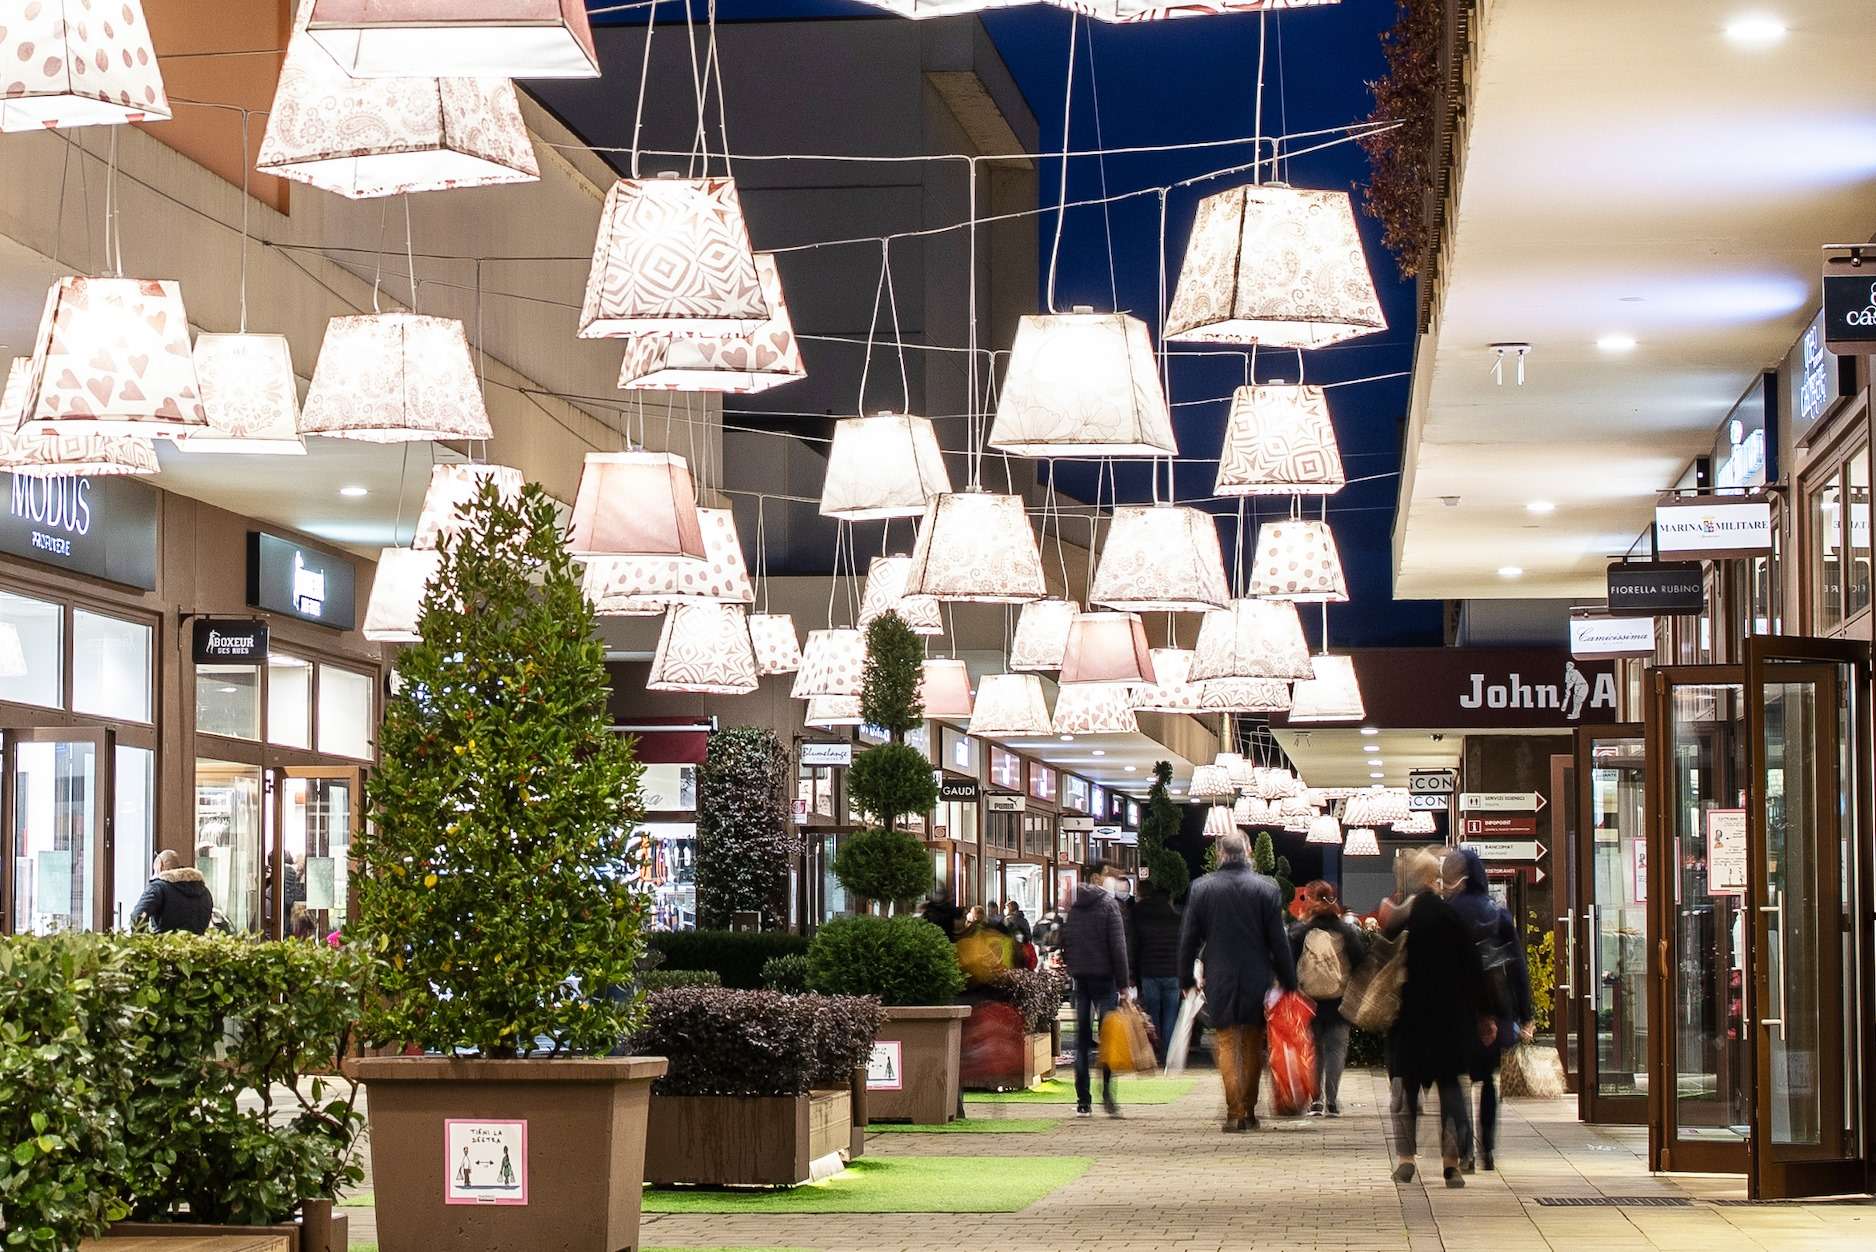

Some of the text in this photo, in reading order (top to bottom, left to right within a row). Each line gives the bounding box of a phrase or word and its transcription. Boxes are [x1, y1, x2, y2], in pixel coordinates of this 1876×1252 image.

[11, 472, 90, 535] MODUS
[1660, 520, 1769, 533] MARINA MILITARE
[1611, 584, 1700, 594] FIORELLA RUBINO
[214, 637, 254, 648] BOXEUR
[1460, 673, 1560, 708] John
